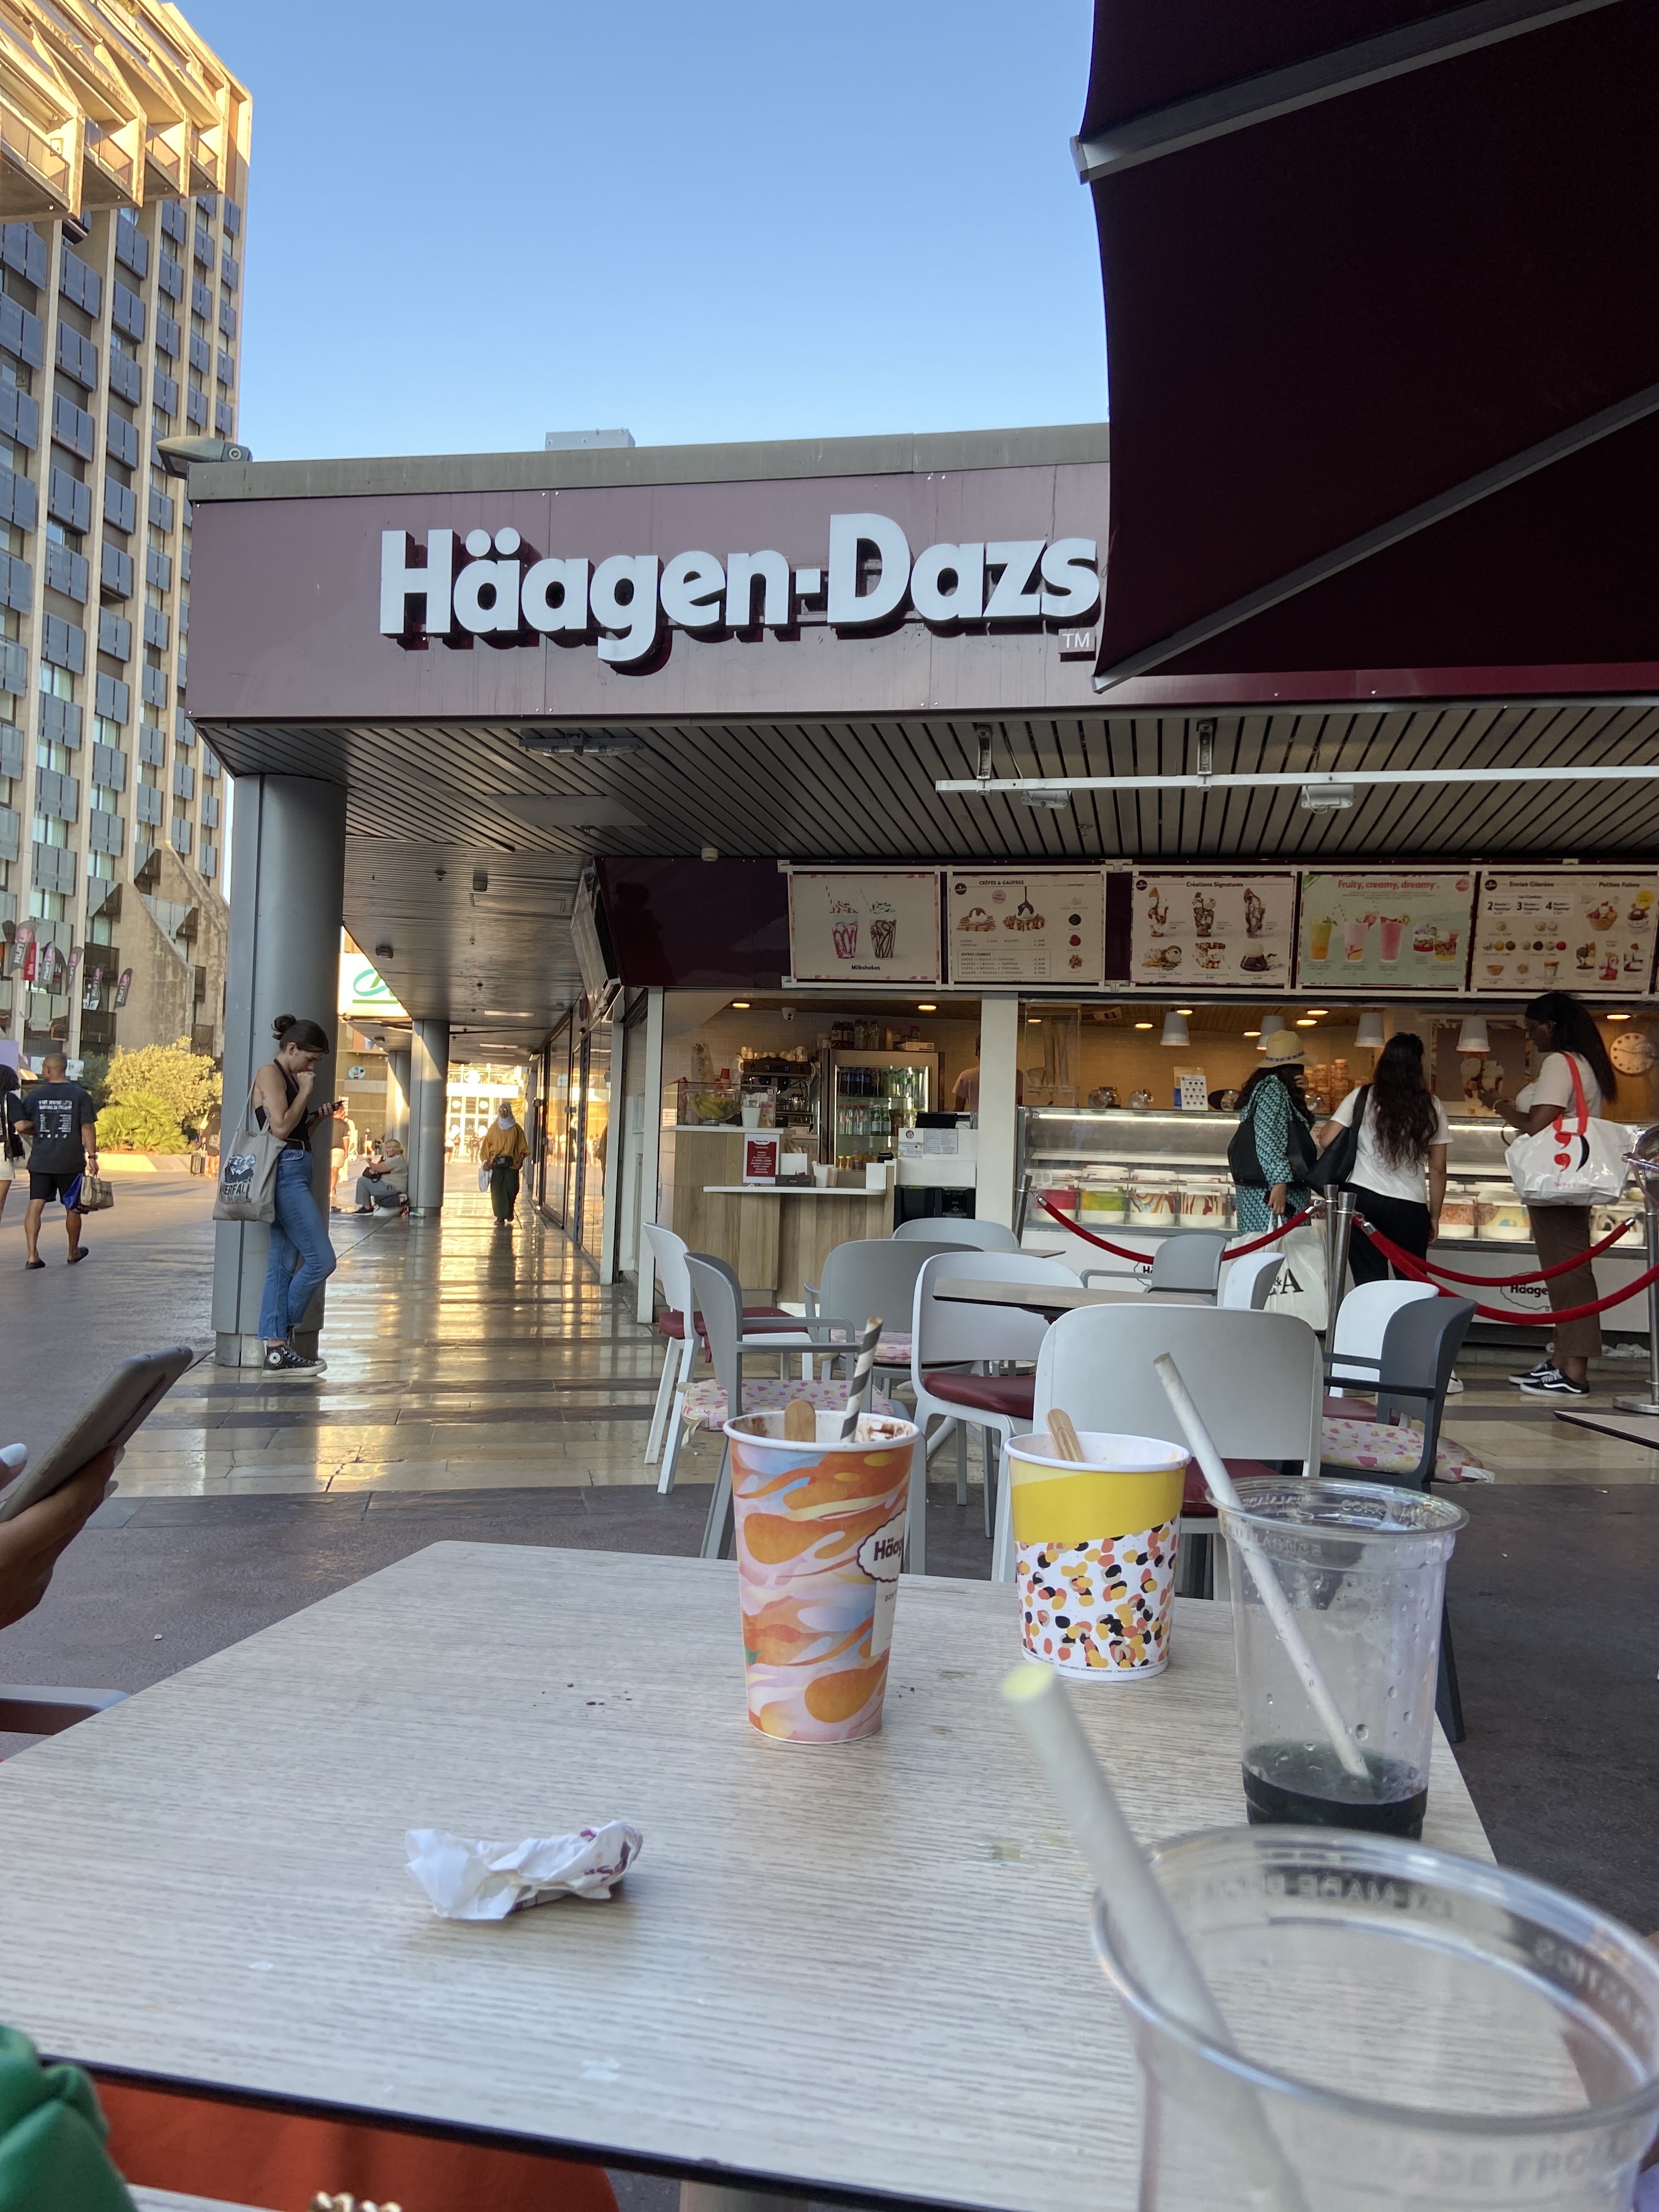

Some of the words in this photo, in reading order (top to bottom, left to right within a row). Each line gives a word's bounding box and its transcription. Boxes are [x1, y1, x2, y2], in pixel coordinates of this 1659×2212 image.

[380, 512, 1099, 663] Häagen-Dazs
[1062, 632, 1090, 648] TM
[1338, 880, 1364, 889] Fruity,
[1365, 882, 1400, 890] creamy,
[1269, 1268, 1304, 1296] &A
